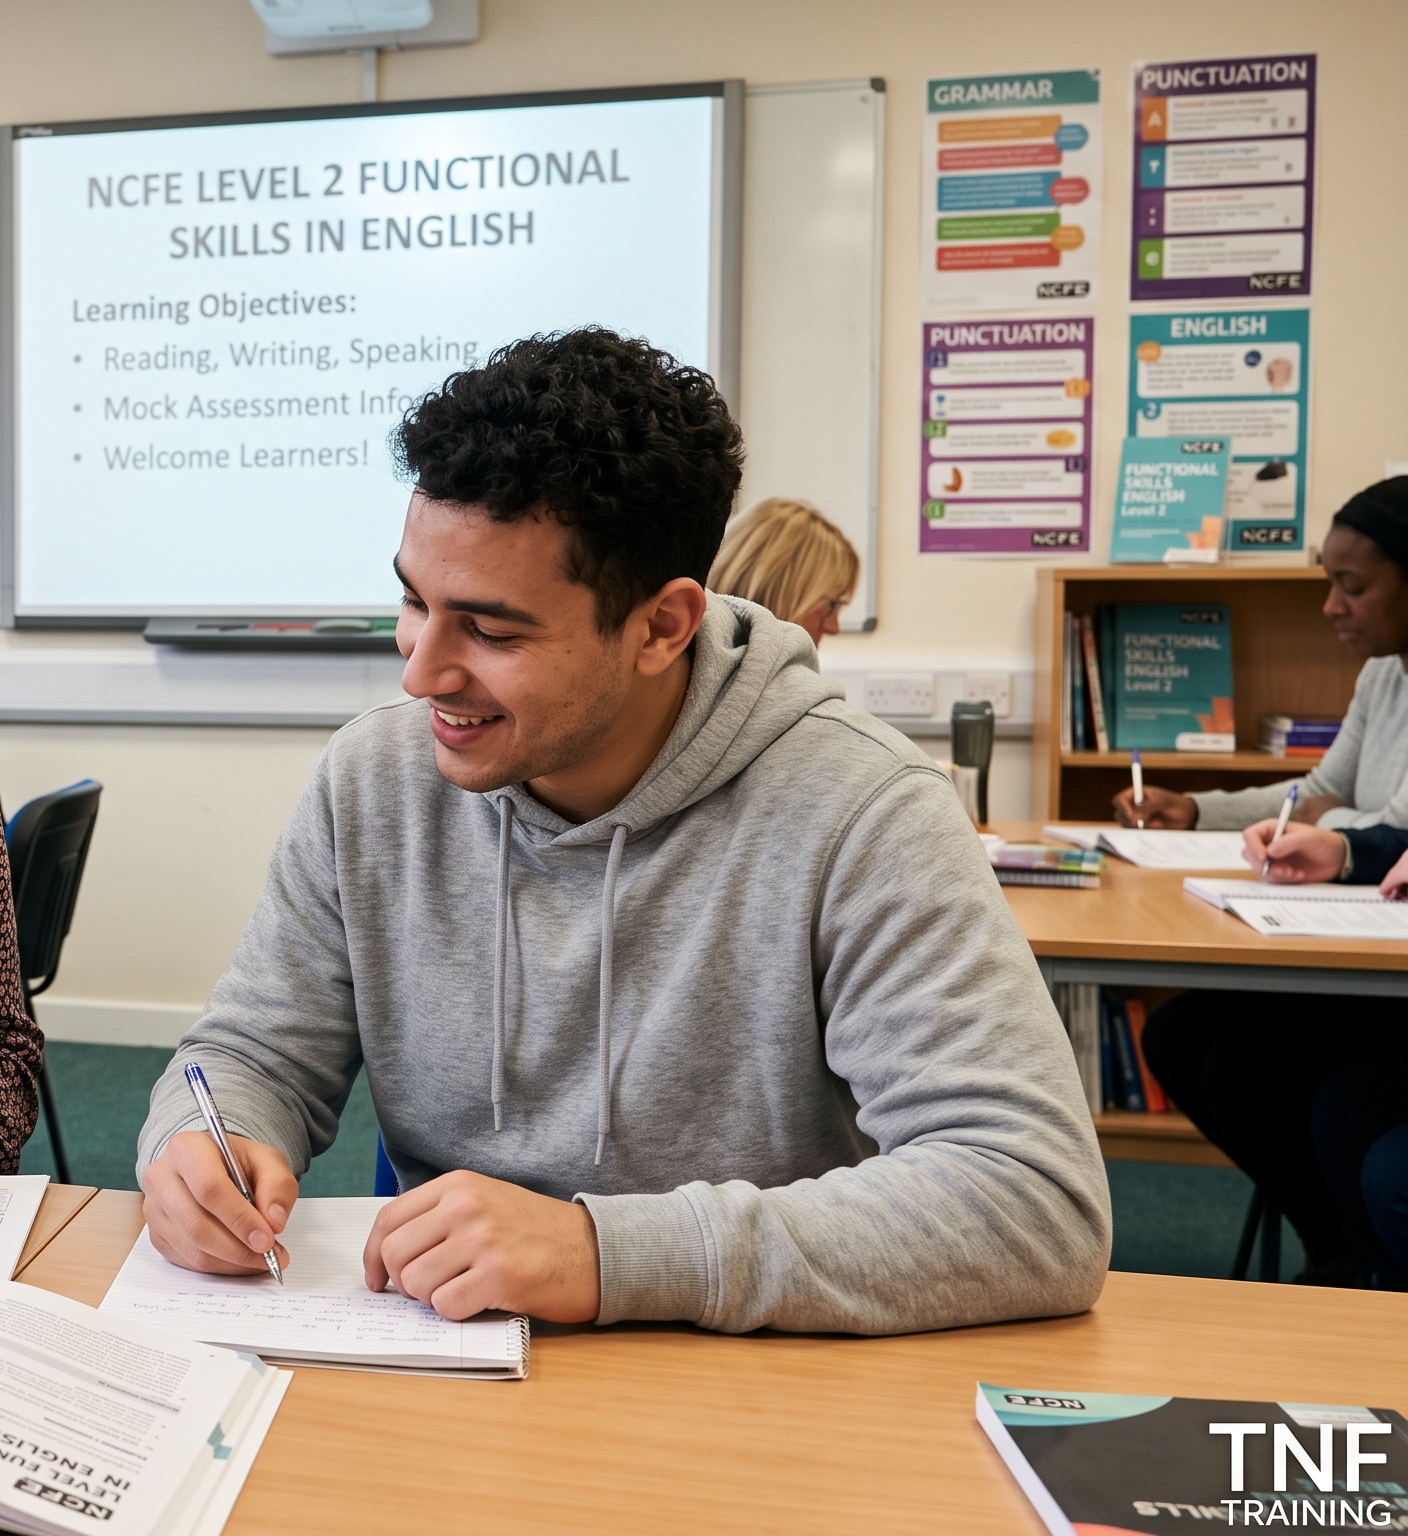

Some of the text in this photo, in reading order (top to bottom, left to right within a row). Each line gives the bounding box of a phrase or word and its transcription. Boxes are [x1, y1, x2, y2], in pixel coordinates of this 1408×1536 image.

[1143, 61, 1308, 90] PUNCTUATION
[934, 79, 1053, 105] GRAMMAR
[88, 149, 629, 208] NCFE LEVEL 2 FUNCTIONAL
[170, 211, 533, 259] SKILLS IN ENGLISH
[1249, 274, 1302, 290] NCFE
[1039, 284, 1087, 297] NCFE
[73, 290, 356, 325] Learning Objectives:
[930, 323, 1086, 347] PUNCTUATION
[1170, 316, 1267, 338] ENGLISH
[104, 336, 479, 375] Reading, Writing, Speaking
[104, 387, 412, 420] Mock Assessment Info
[104, 440, 368, 470] Welcome Learners!
[1125, 462, 1218, 477] FUNCTIONAL
[1125, 476, 1173, 489] SKILLS
[1122, 489, 1186, 503] ENGLISH
[1121, 504, 1156, 517] Level
[1033, 532, 1080, 546] NCFE
[1242, 529, 1293, 543] NCFE
[1124, 633, 1221, 649] FUNCTIONAL
[1124, 649, 1175, 663] SKILLS
[1124, 664, 1189, 679] ENGLISH
[1124, 679, 1161, 692] Level
[1008, 1395, 1082, 1409] NCFE
[50, 1468, 121, 1503] LEVEL
[105, 1475, 130, 1491] IN
[23, 1478, 109, 1519] NCFE
